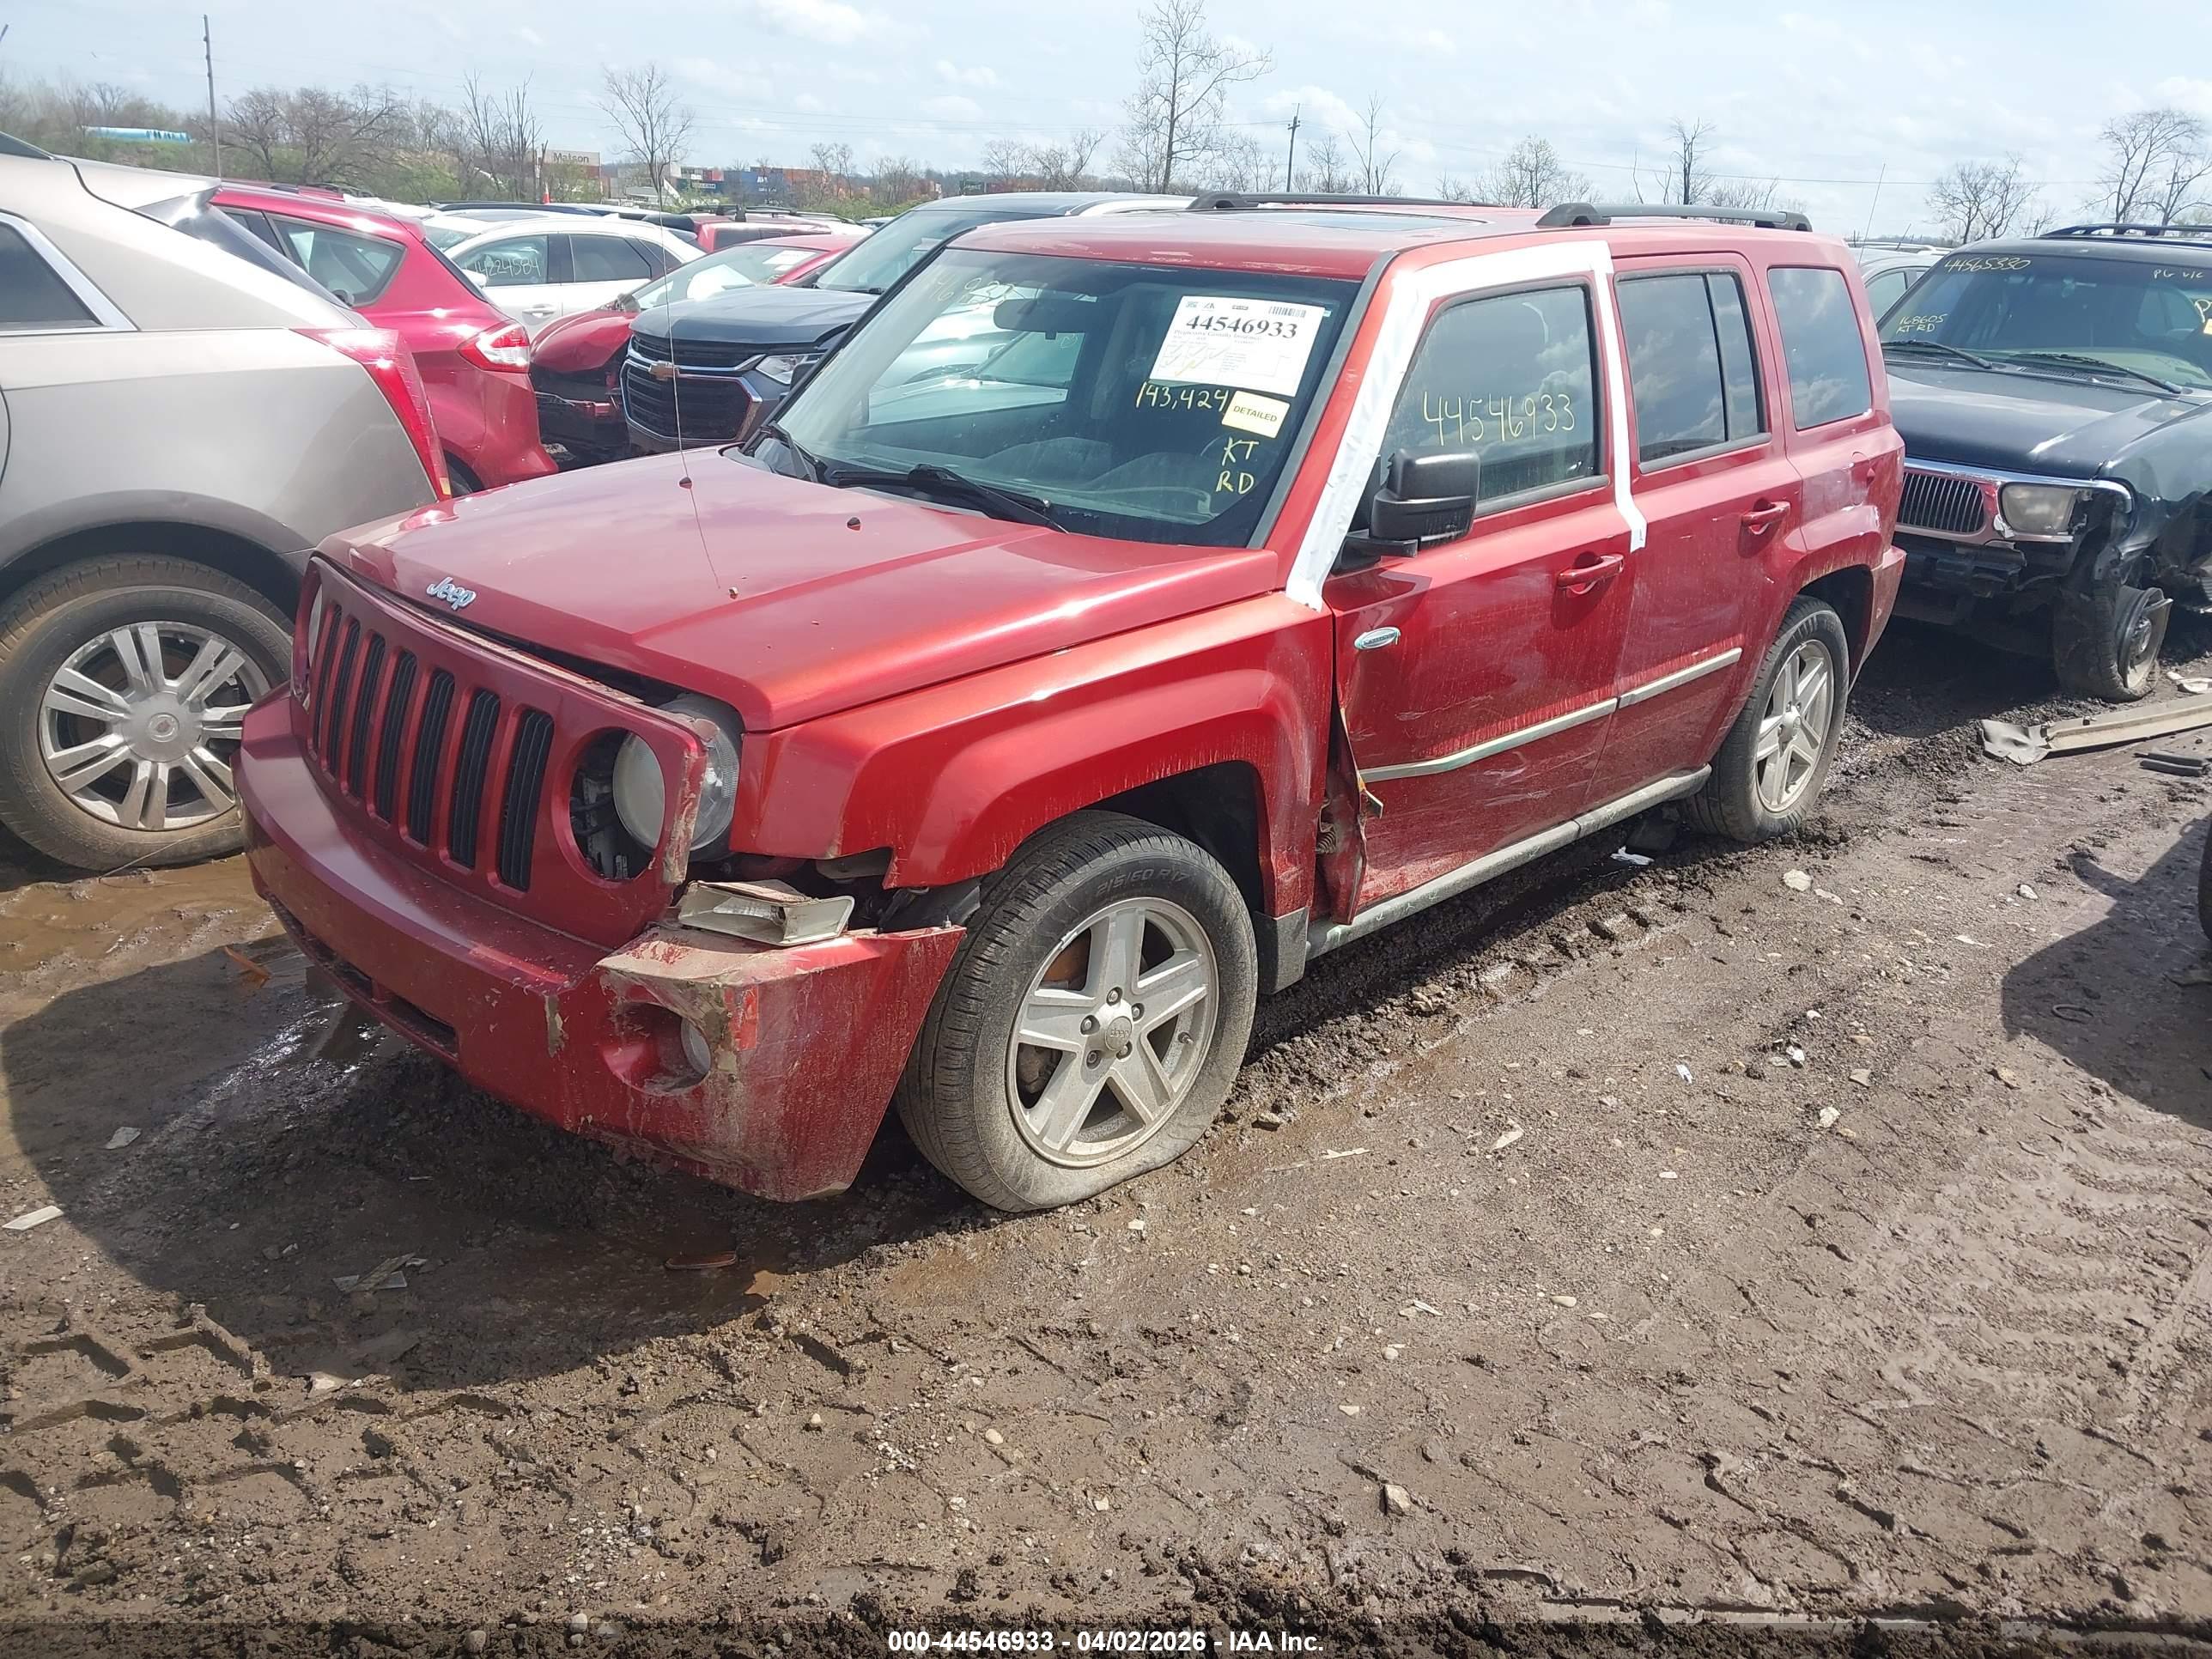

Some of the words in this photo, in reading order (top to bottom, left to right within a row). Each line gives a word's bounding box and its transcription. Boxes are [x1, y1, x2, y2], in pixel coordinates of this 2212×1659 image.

[1186, 314, 1298, 339] 44546933
[1134, 380, 1230, 411] 143,424
[1232, 404, 1278, 422] DETAILED
[1422, 391, 1576, 447] 44546933
[1221, 436, 1260, 466] KT
[1215, 470, 1255, 495] RD
[426, 576, 477, 611] Jeep
